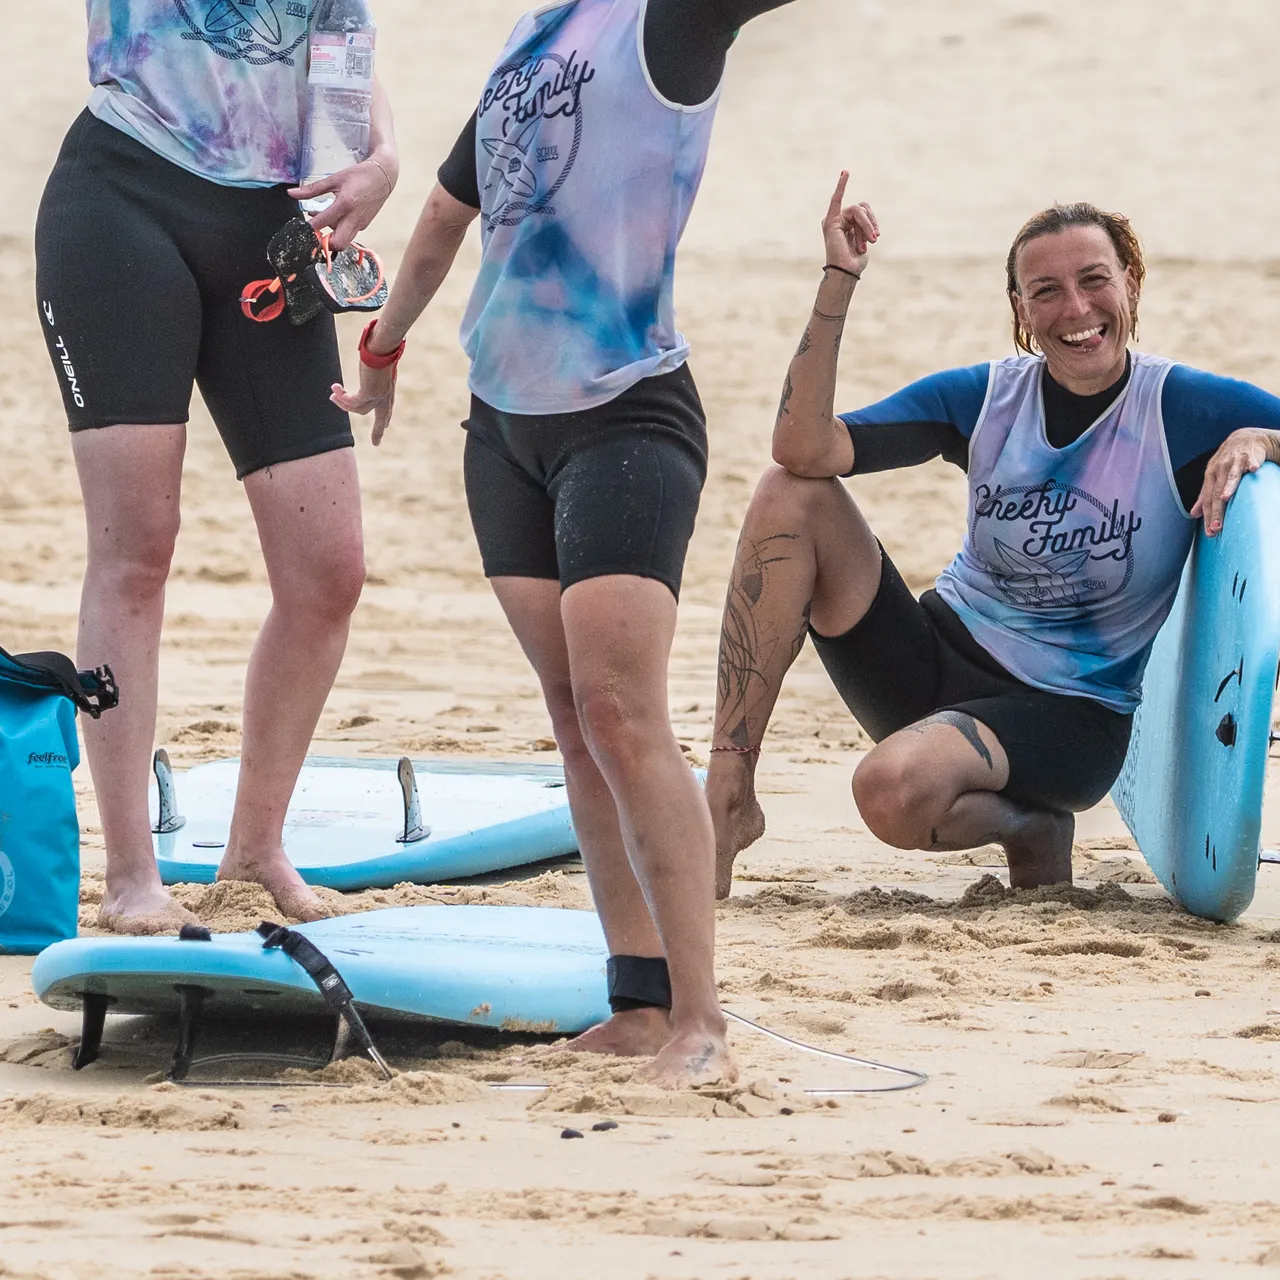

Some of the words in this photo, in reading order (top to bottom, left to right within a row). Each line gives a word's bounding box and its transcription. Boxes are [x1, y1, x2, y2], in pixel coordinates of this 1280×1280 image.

[286, 2, 307, 15] SCHOOL
[233, 26, 253, 39] CAMP
[478, 56, 544, 118] eeky
[536, 145, 559, 158] SCHOOL
[975, 478, 1077, 521] Cheeky
[1022, 499, 1142, 561] Family
